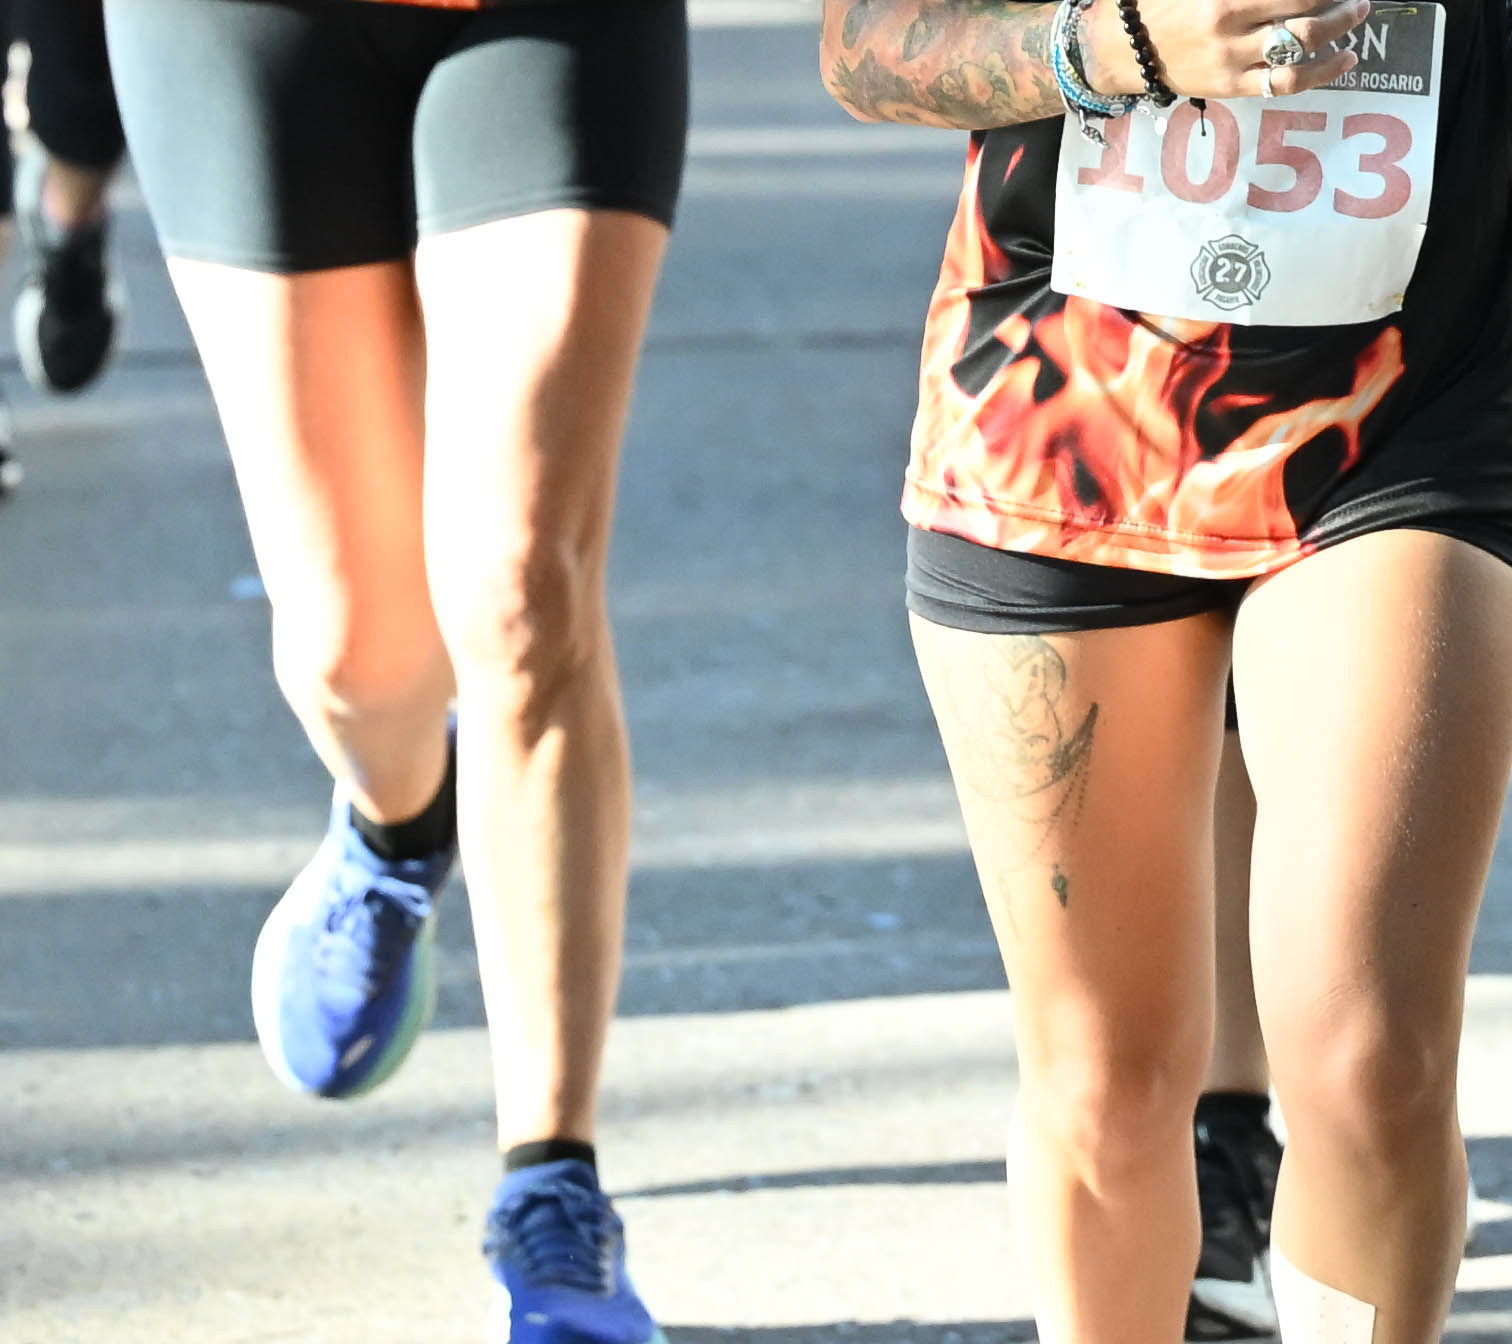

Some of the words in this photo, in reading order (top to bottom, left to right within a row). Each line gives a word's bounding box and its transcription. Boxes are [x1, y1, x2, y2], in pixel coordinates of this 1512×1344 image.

[1361, 72, 1425, 94] ROSARIO
[1076, 97, 1414, 220] 1053
[1215, 256, 1248, 284] 27
